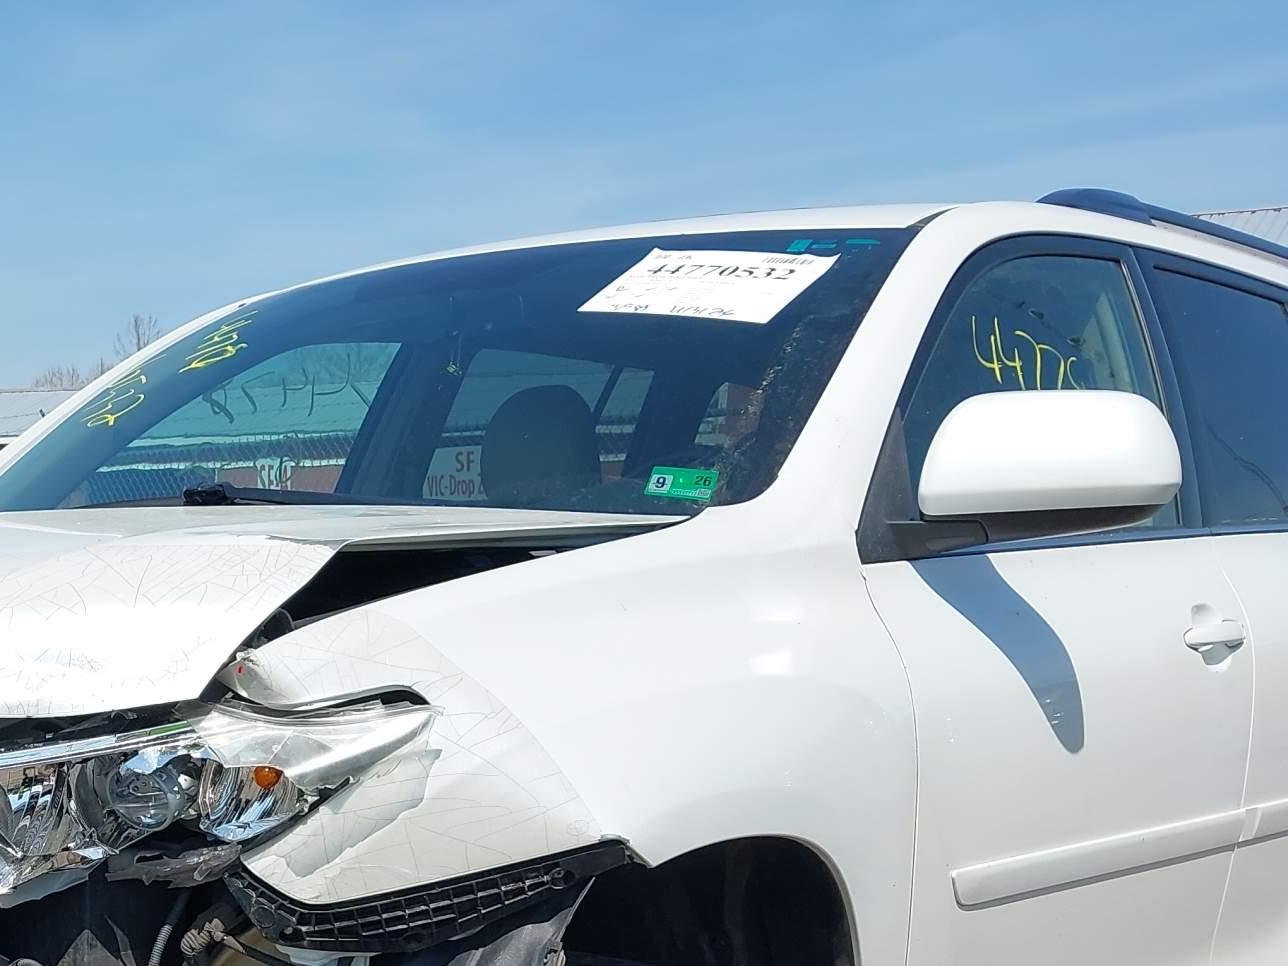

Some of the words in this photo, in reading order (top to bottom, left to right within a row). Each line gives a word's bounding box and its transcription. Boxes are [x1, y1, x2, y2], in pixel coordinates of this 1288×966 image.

[646, 262, 798, 281] 44770532
[455, 450, 475, 472] SF
[426, 474, 475, 497] VIC-Drop
[655, 476, 666, 489] 9
[694, 475, 713, 487] 26
